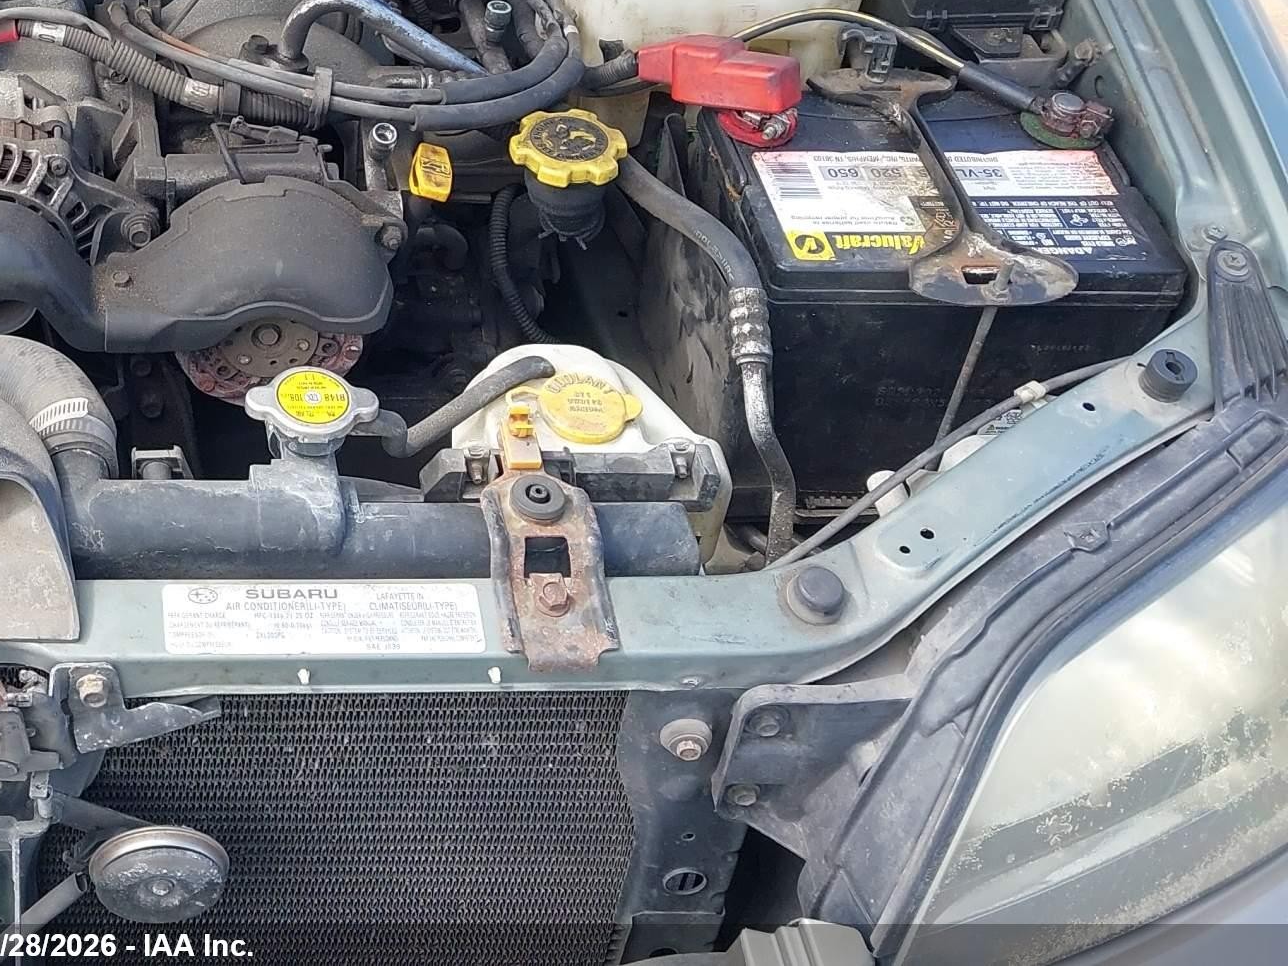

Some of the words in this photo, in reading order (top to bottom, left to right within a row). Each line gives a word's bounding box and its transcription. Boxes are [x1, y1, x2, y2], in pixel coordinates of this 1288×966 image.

[828, 167, 859, 178] 650
[870, 168, 903, 178] 520
[834, 234, 926, 255] Valucraft
[245, 588, 338, 599] SUBARU
[376, 592, 415, 601] LAFAYETTE
[226, 601, 241, 611] AIR
